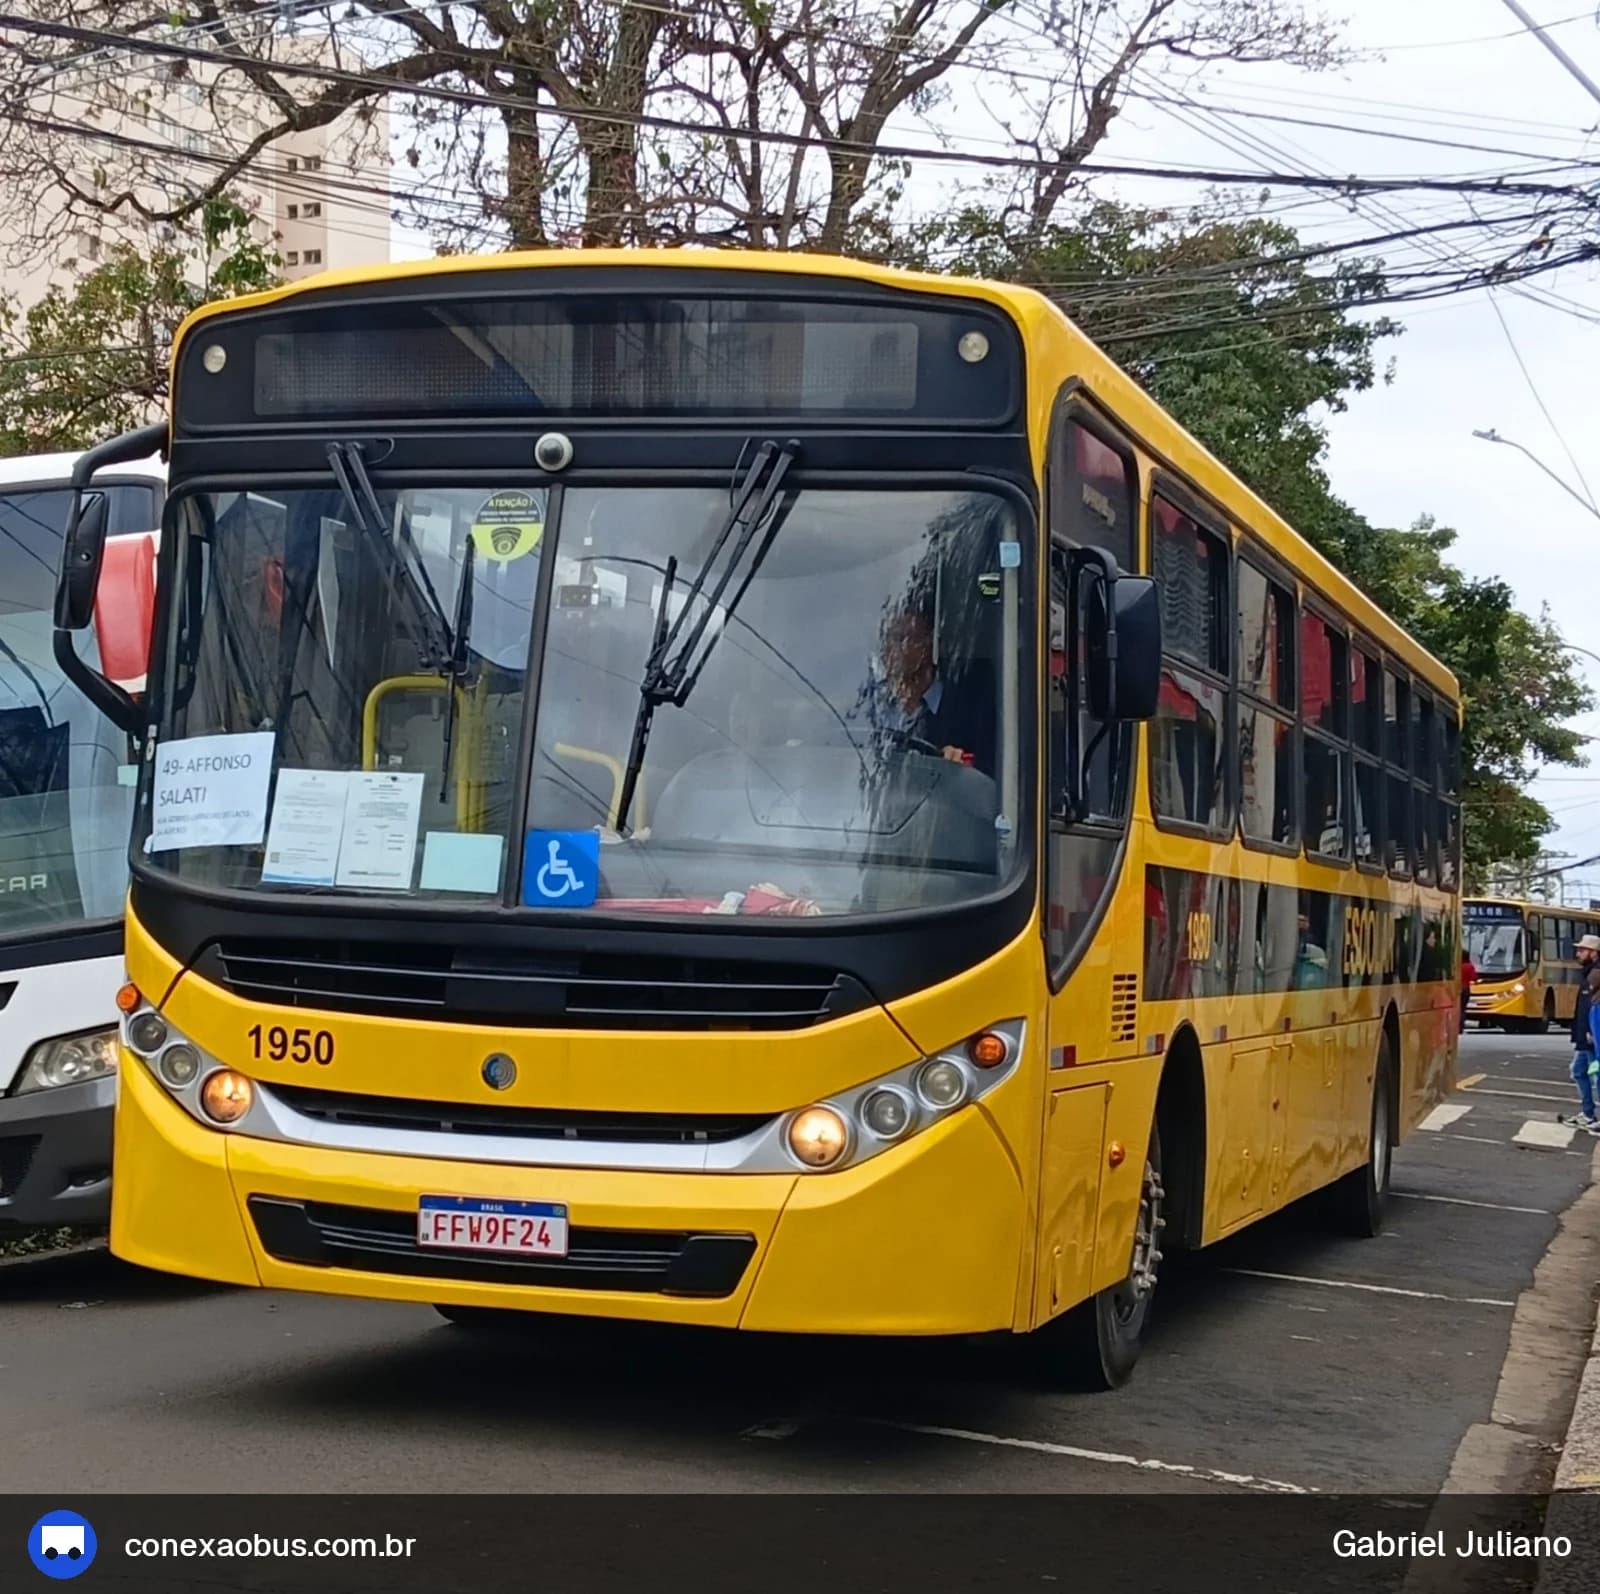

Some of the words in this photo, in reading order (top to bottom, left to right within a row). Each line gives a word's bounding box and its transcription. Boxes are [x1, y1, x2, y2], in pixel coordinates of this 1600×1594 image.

[162, 759, 184, 776] 49-
[186, 753, 252, 773] AFFONSO
[159, 786, 207, 807] SALATI
[1187, 911, 1211, 960] 1950
[248, 1024, 335, 1066] 1950
[480, 1203, 504, 1212] BRASIL
[433, 1213, 551, 1248] FFW9F24
